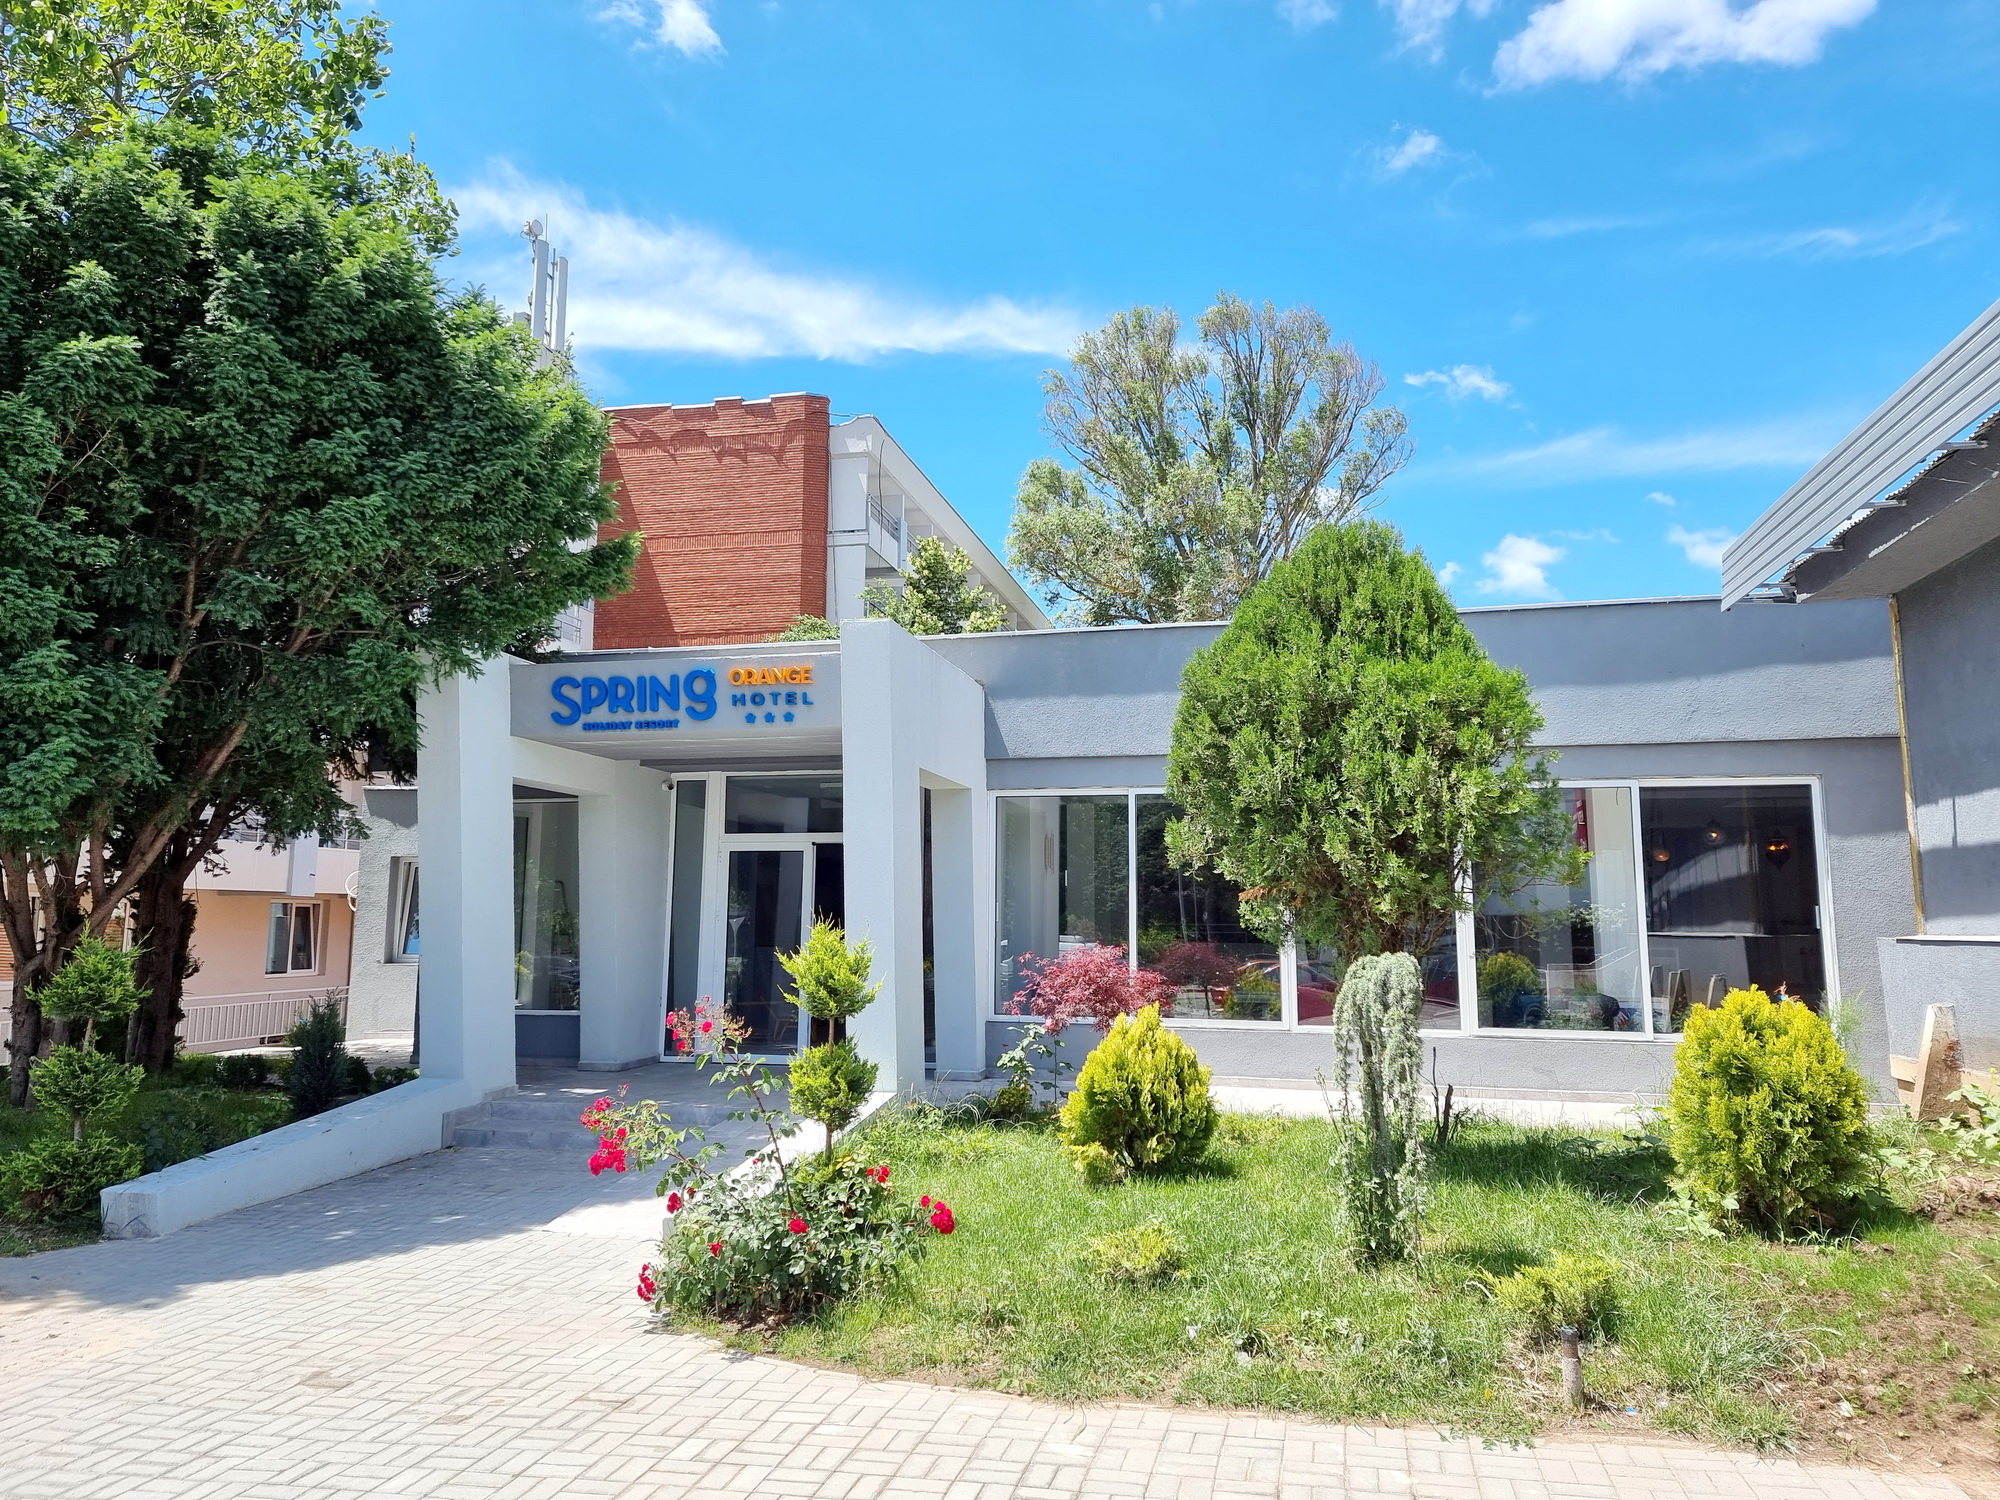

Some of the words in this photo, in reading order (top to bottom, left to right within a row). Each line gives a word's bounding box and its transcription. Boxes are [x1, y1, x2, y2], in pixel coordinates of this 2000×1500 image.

[728, 665, 814, 686] ORANGE
[731, 691, 814, 707] HOTEL
[581, 720, 633, 731] HOLIDAY
[634, 718, 680, 730] RESORT
